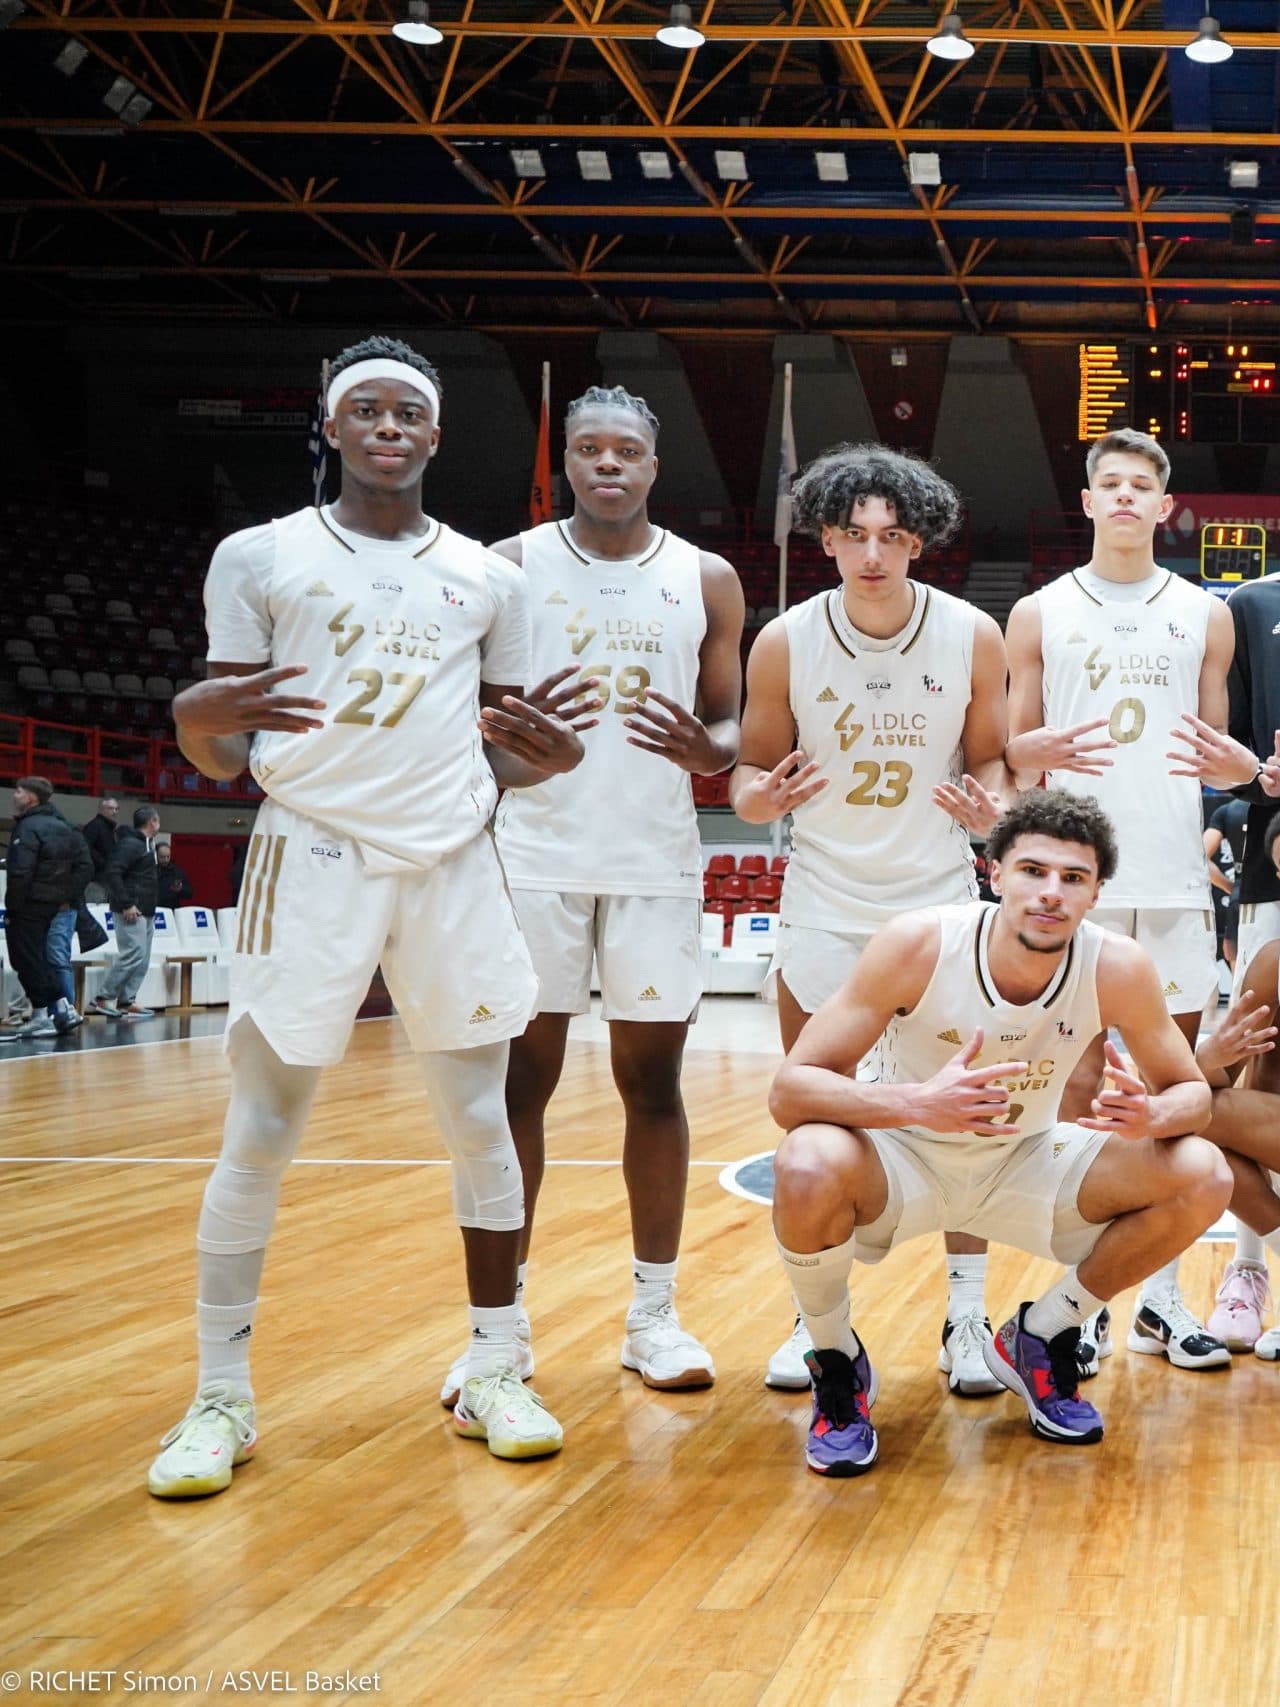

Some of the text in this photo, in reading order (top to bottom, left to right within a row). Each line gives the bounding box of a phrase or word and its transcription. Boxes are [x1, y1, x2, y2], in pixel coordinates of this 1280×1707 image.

[375, 618, 441, 641] LDLC
[605, 618, 664, 637] LDLC
[375, 640, 441, 661] ASVEL
[605, 639, 664, 654] ASVEL
[1118, 653, 1171, 671] LDLC
[574, 664, 651, 715] 69
[1119, 673, 1169, 687] ASVEL
[333, 668, 426, 728] 27
[871, 713, 928, 731] LDLC
[1108, 697, 1146, 744] 0
[871, 734, 927, 747] ASVEL
[846, 760, 913, 808] 23
